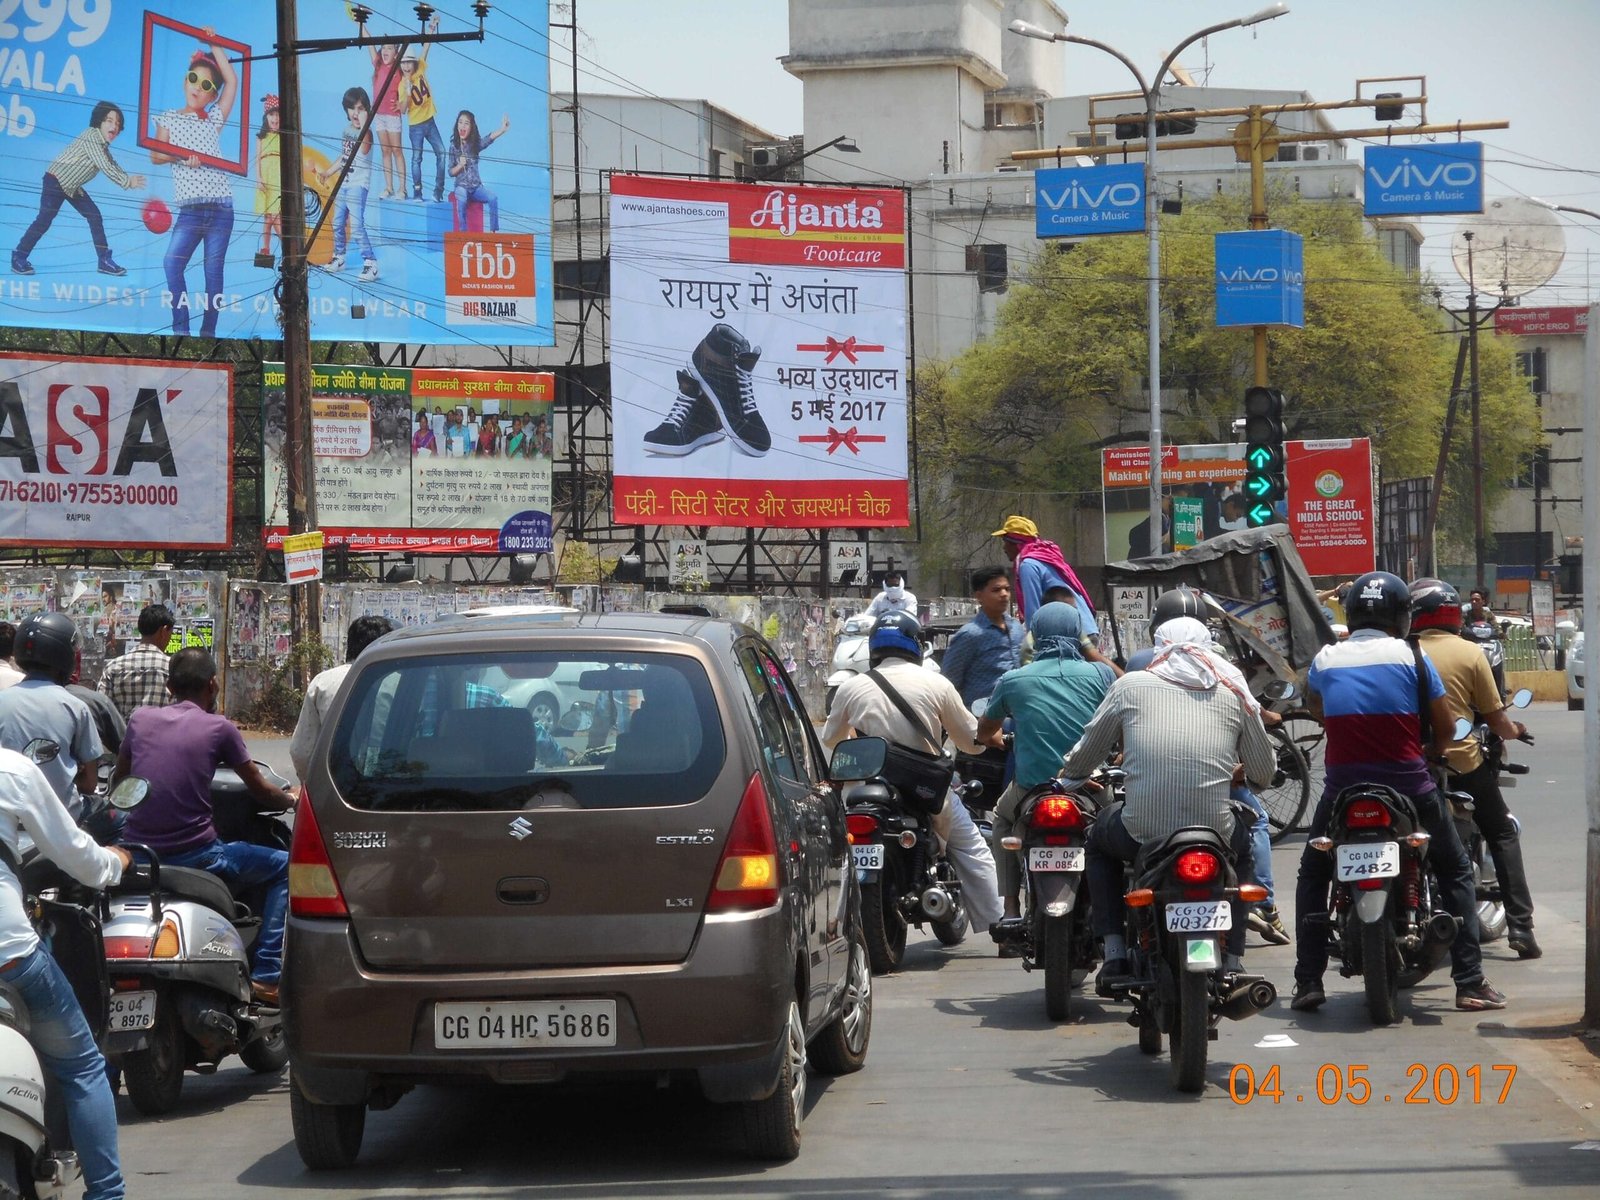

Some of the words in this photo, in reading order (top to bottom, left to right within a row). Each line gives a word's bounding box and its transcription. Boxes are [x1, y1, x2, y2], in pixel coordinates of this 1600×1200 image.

[1381, 192, 1421, 203] Camera
[1423, 191, 1432, 201] &
[1434, 189, 1465, 201] Music
[621, 203, 726, 217] www.ajantashoes.com
[750, 189, 883, 238] Ajanta
[1051, 214, 1089, 225] Camera
[1091, 212, 1099, 222] &
[1101, 210, 1130, 222] Music
[460, 241, 516, 279] fbb
[803, 245, 882, 263] Footcare
[53, 282, 150, 308] WIDEST
[159, 289, 243, 313] RANGE
[310, 297, 350, 317] IDS
[659, 278, 742, 320] रायपुर
[749, 272, 773, 313] में
[781, 277, 859, 315] अजंता
[777, 367, 817, 390] भव्य
[417, 377, 460, 391] प्रधानमंत्री
[463, 381, 490, 396] सुरक्षा
[493, 378, 513, 393] बीमा
[516, 379, 546, 394] योजना
[791, 400, 803, 421] 5
[839, 400, 887, 421] 2017
[1108, 470, 1143, 482] Making
[1185, 469, 1197, 478] an
[1199, 467, 1249, 480] experience
[669, 489, 709, 516] सिटी
[711, 489, 750, 517] सेंटर
[755, 489, 786, 517] और
[855, 490, 892, 517] चौक
[1303, 500, 1323, 511] THE
[1325, 499, 1357, 510] GREAT
[66, 513, 91, 522] RAIPUR
[1296, 512, 1324, 523] INDIA
[1325, 510, 1365, 522] SCHOOL
[504, 536, 520, 549] 1800
[521, 536, 534, 549] 233
[535, 536, 552, 549] 2021
[837, 546, 863, 558] ASA
[1120, 590, 1144, 600] ASA
[333, 831, 387, 839] MARUTI
[655, 835, 714, 845] ESTILO
[334, 838, 387, 849] SUZUKI
[1039, 850, 1053, 859] CG
[1063, 850, 1075, 859] 04
[1349, 853, 1361, 861] CG
[1363, 851, 1373, 860] 04
[1034, 860, 1049, 869] KR
[1055, 860, 1079, 869] 0854
[1342, 862, 1393, 877] 7482
[201, 941, 234, 957] Activa
[128, 997, 143, 1012] 04
[121, 1014, 150, 1028] 8976
[442, 1015, 470, 1039] CG
[478, 1015, 505, 1039] 04
[511, 1014, 539, 1039] HC
[547, 1014, 610, 1038] 5686
[7, 1086, 39, 1102] Activa
